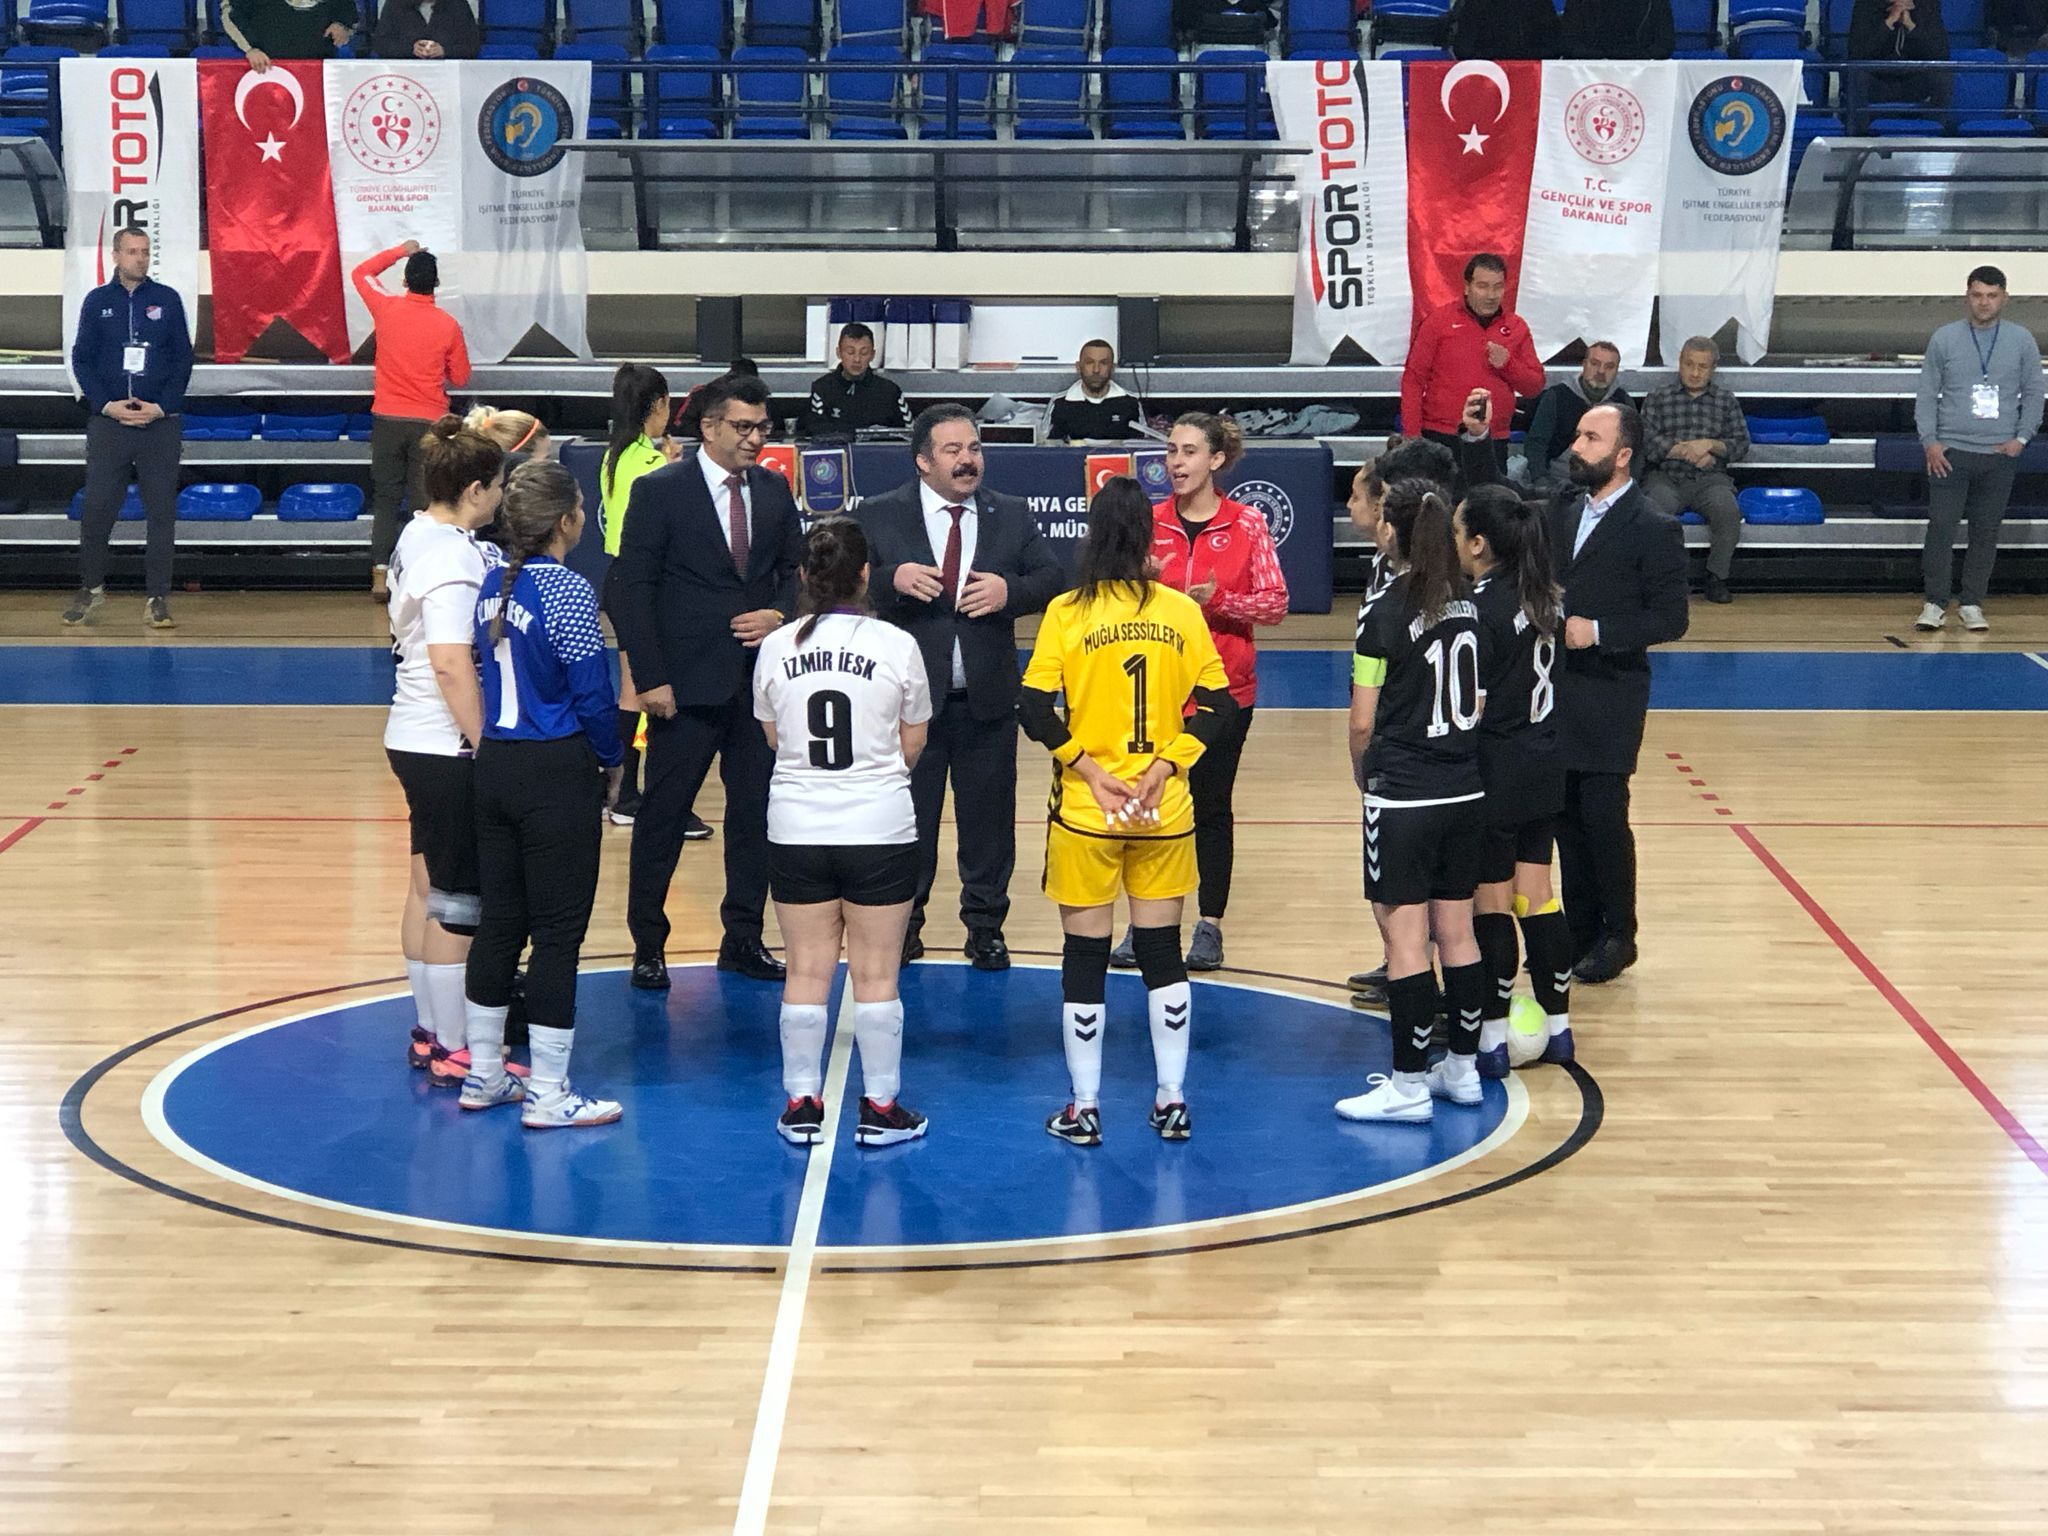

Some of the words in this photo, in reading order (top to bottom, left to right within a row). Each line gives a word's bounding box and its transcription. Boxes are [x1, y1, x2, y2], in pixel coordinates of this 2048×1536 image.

[110, 68, 148, 194] TOTO
[1584, 176, 1612, 193] T.C.
[1717, 187, 1752, 197] TÜRKİYE
[356, 194, 391, 203] GENÇLİK
[393, 194, 404, 202] VE
[368, 204, 414, 213] BAKANLIĞI
[1540, 189, 1594, 208] GENÇLİK
[1599, 200, 1615, 211] VE
[1619, 201, 1653, 214] SPOR
[1682, 200, 1710, 209] İŞİTME
[1562, 206, 1628, 226] BAKANLIĞI
[1703, 213, 1766, 223] FEDERASYONU
[1027, 496, 1062, 513] HYA
[1064, 496, 1087, 513] GE
[1049, 518, 1090, 538] MÜD
[1084, 624, 1120, 656] MUĞLA
[1120, 618, 1175, 647] SESSİZLER
[781, 646, 833, 681] İZMİR
[838, 646, 877, 681] İESK
[494, 637, 519, 730] 1
[1424, 630, 1480, 738] 10
[1529, 635, 1556, 724] 8
[1122, 653, 1154, 754] 1
[807, 689, 854, 771] 9
